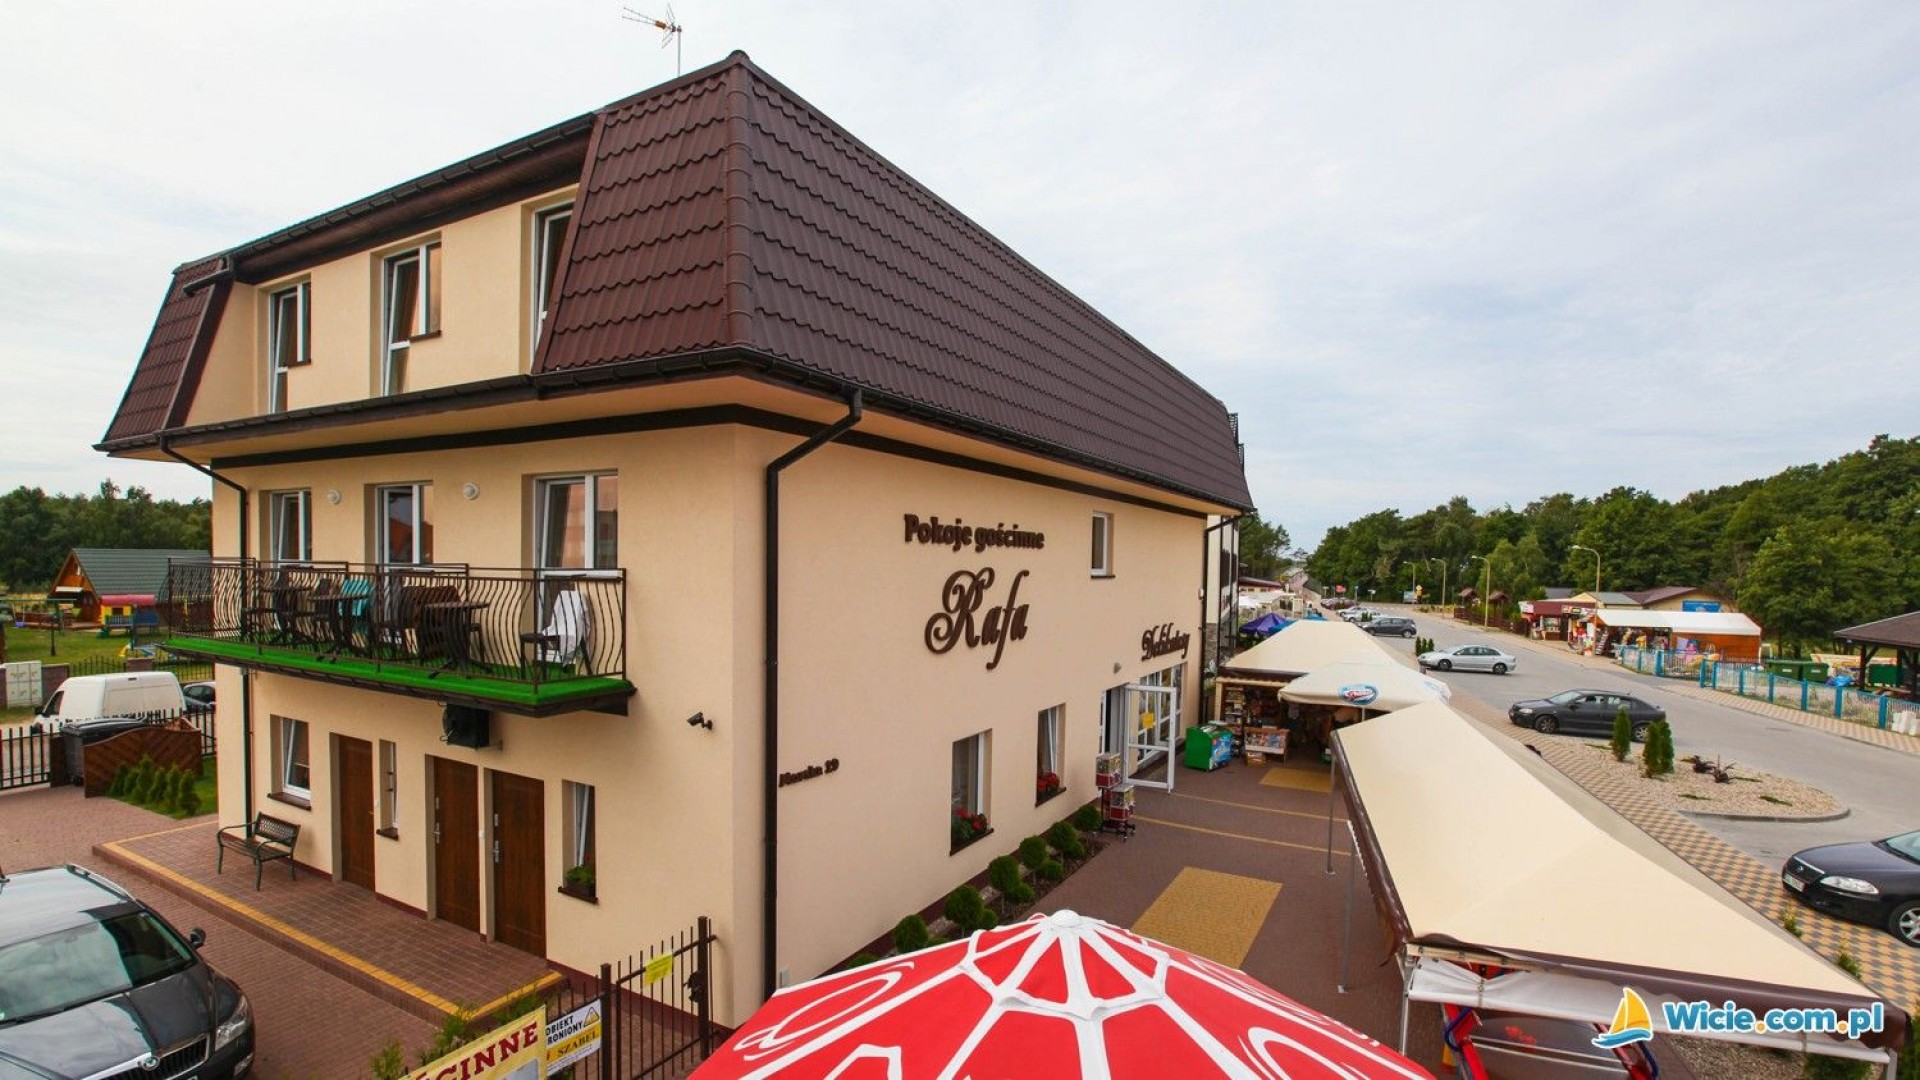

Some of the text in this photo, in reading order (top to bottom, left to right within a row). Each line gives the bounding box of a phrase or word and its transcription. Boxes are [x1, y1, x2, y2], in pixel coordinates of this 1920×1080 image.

[904, 513, 1045, 553] Pokoje gościnne
[925, 566, 1030, 671] Rafa
[415, 1022, 539, 1080] CINNE
